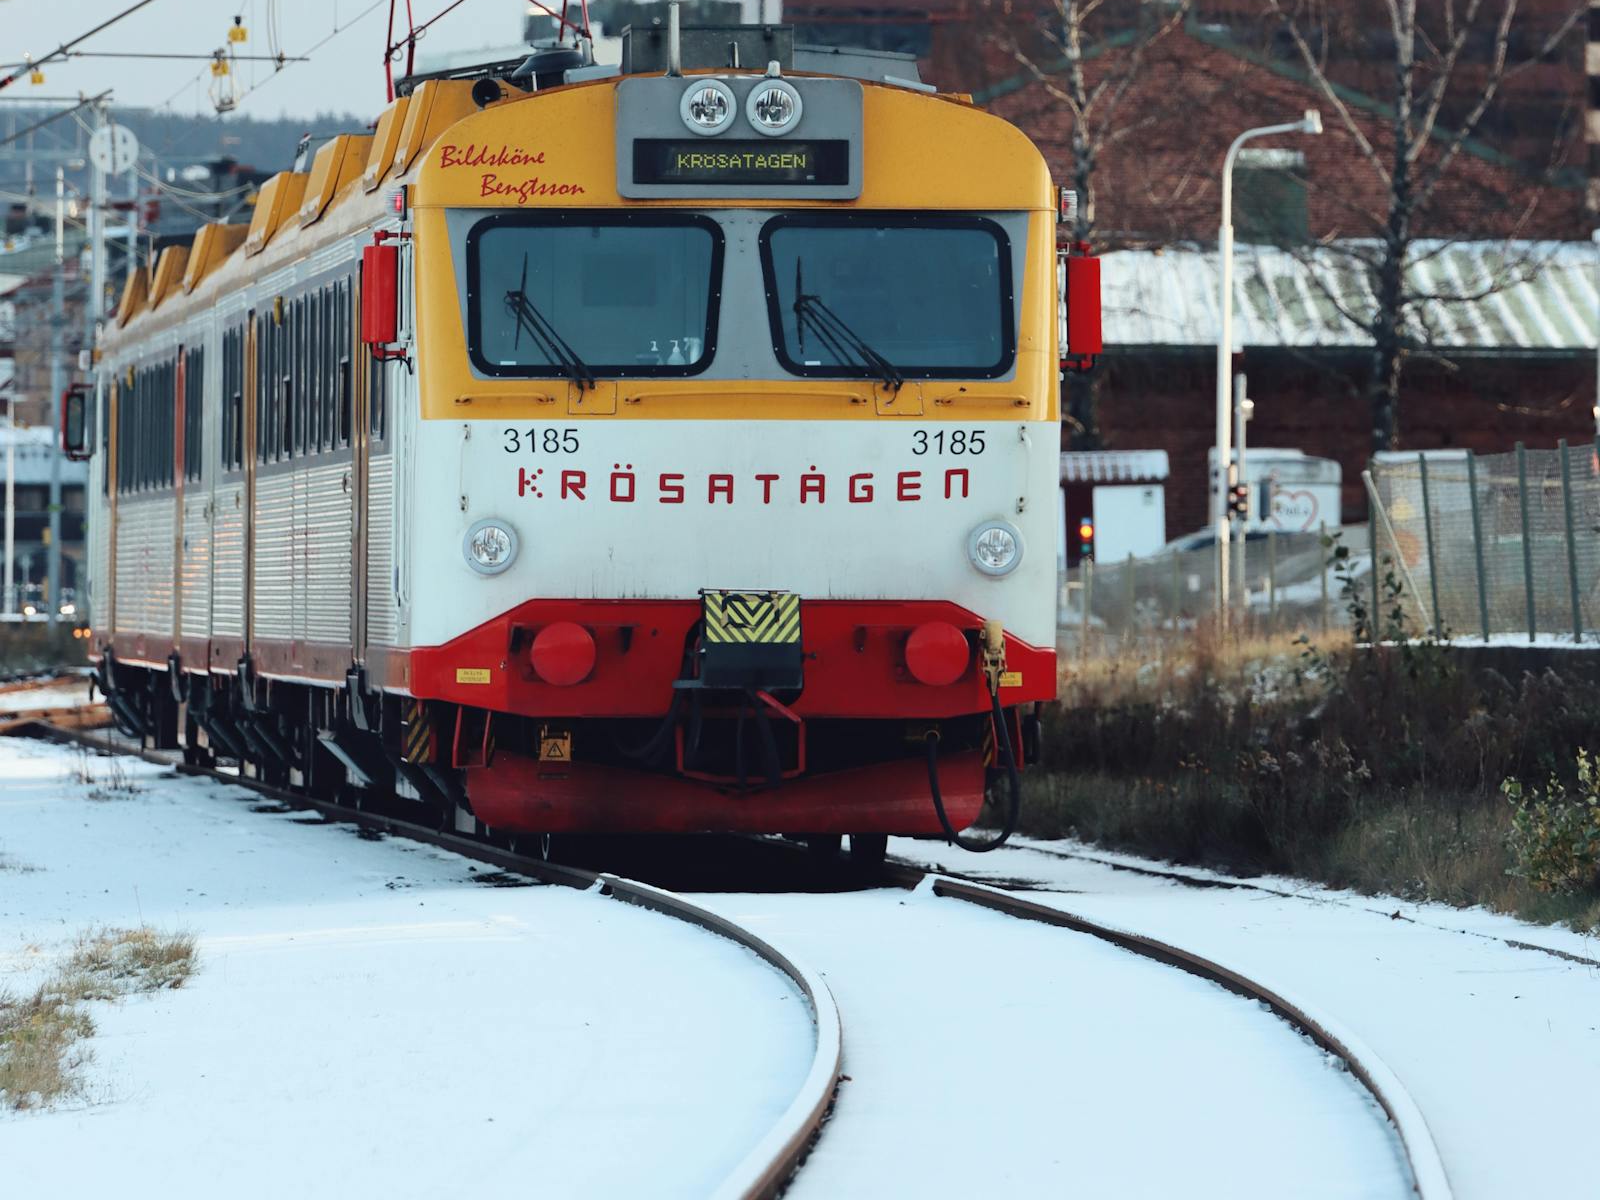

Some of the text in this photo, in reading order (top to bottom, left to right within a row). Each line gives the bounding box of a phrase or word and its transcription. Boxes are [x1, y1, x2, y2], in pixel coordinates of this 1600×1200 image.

[440, 144, 545, 168] Bildsköne
[480, 173, 585, 204] Bengtsson
[503, 428, 580, 453] 3185
[912, 430, 986, 455] 3185
[518, 463, 969, 504] KRÖSATÅGEN
